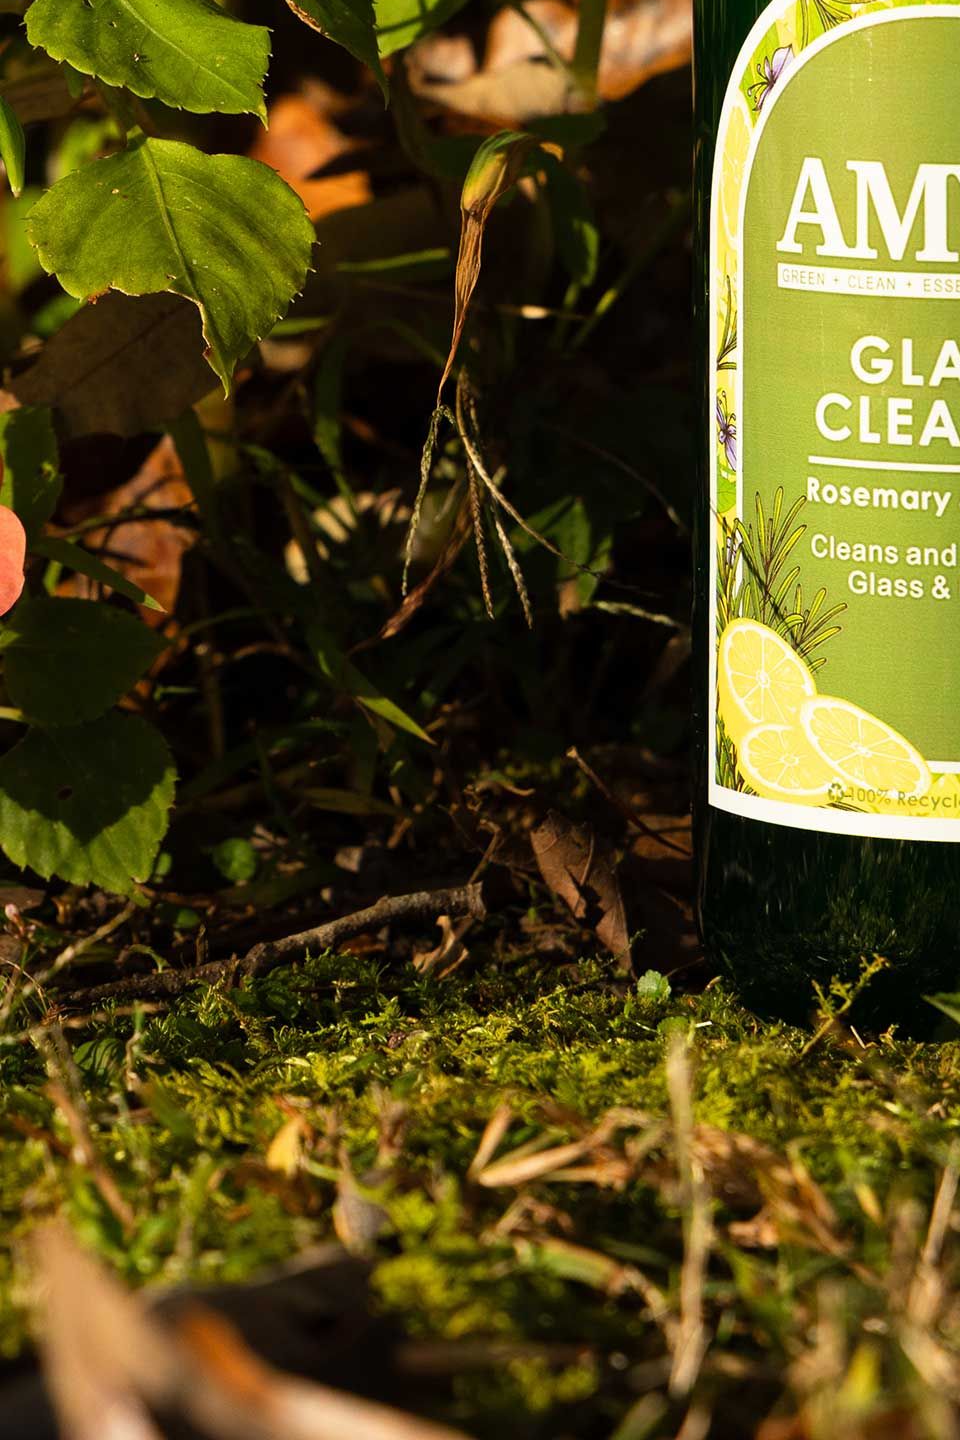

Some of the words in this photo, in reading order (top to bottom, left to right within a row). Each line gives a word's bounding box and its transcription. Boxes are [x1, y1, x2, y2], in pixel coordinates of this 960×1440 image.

[782, 268, 825, 285] GREEN
[847, 274, 896, 290] CLEAN
[807, 476, 951, 517] Rosemary
[811, 534, 898, 565] Cleans
[906, 543, 957, 566] and
[848, 570, 923, 598] Glass
[931, 575, 950, 599] &
